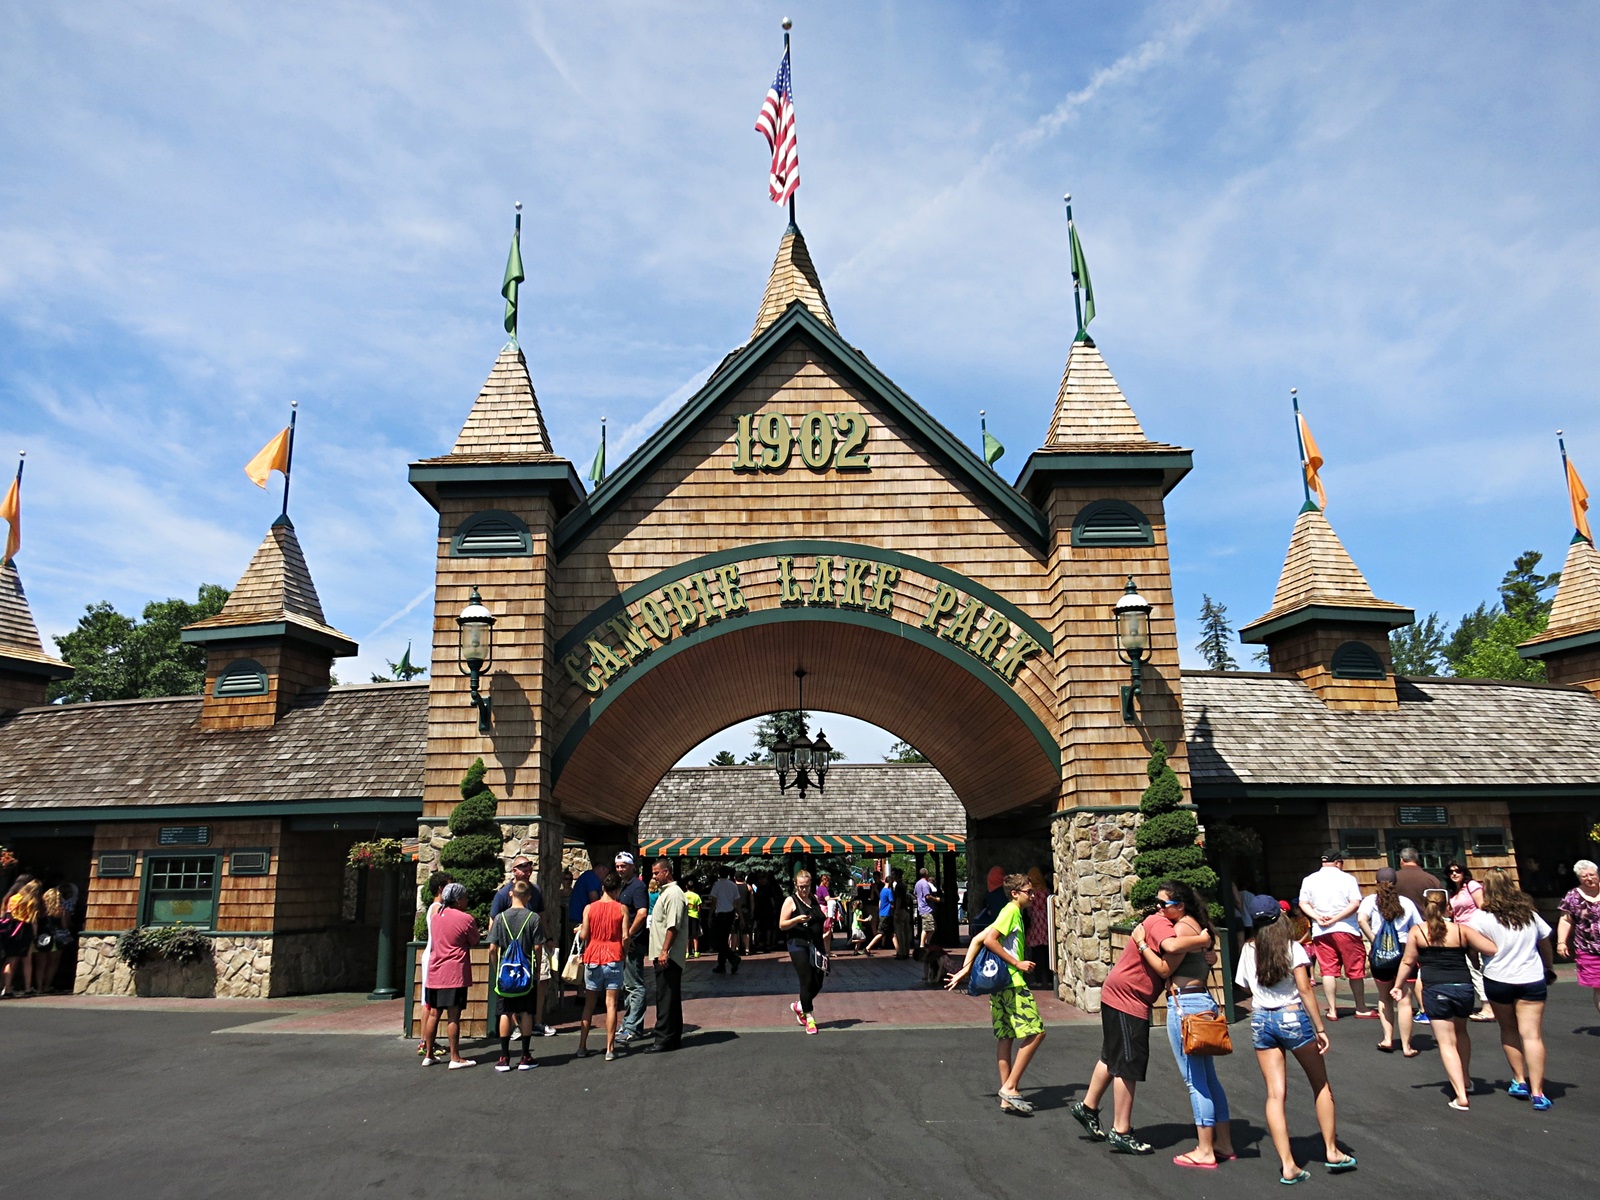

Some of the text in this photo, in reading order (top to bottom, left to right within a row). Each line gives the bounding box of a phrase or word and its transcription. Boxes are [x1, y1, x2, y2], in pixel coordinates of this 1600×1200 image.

[733, 411, 870, 471] 1902
[563, 555, 1043, 695] CANOBIE LAKE PARK
[333, 820, 340, 829] 6
[1273, 804, 1280, 814] 7
